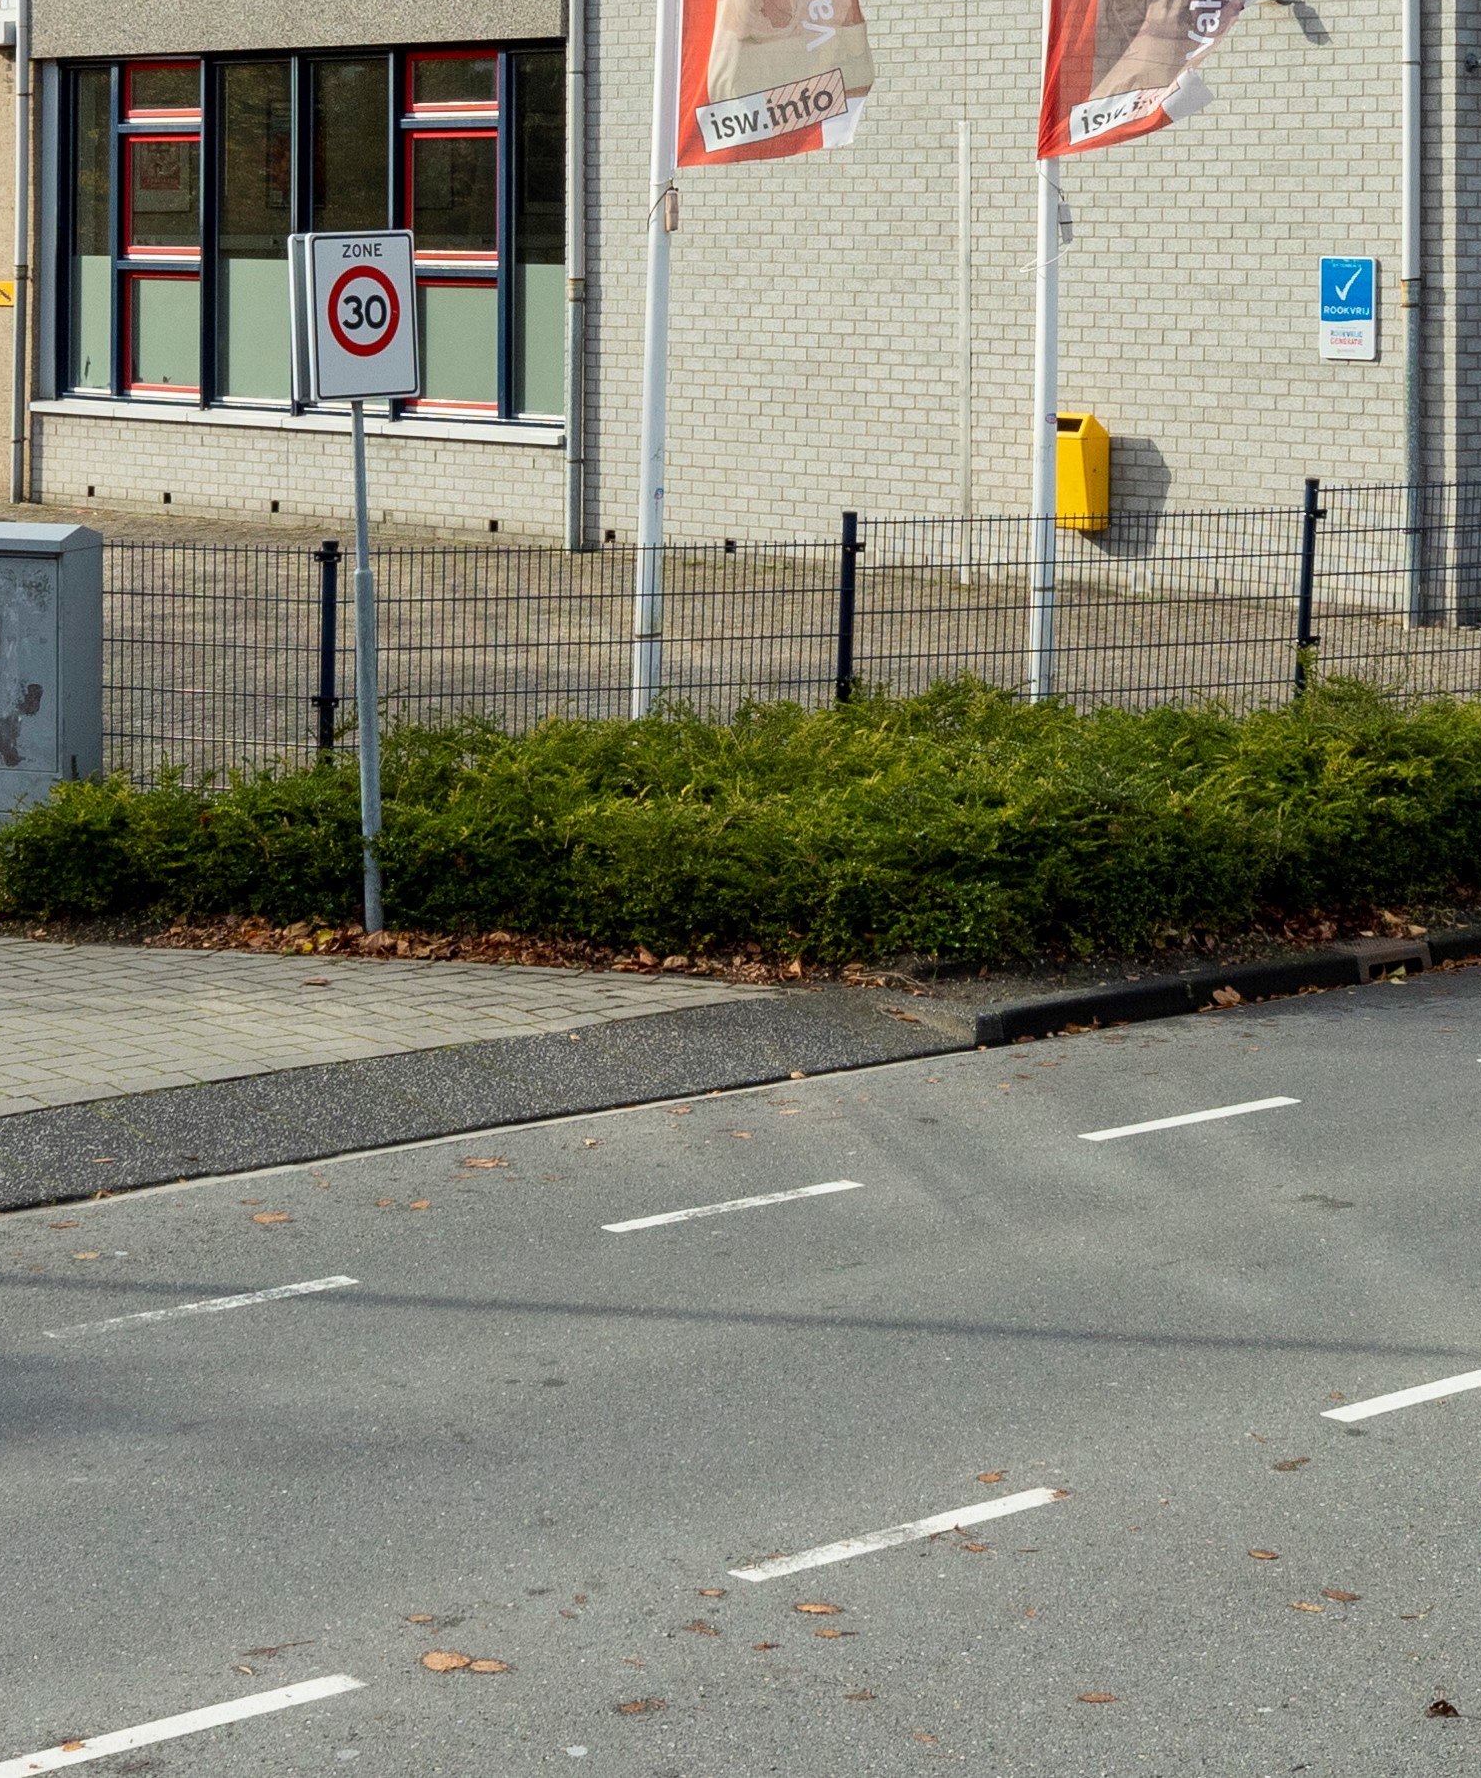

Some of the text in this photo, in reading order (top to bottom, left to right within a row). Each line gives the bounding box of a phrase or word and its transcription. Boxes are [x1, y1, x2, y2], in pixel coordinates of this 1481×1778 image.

[710, 87, 834, 140] isw.info
[342, 243, 383, 258] ZONE
[342, 294, 387, 330] 30
[1323, 305, 1370, 316] ROOKVRIJ
